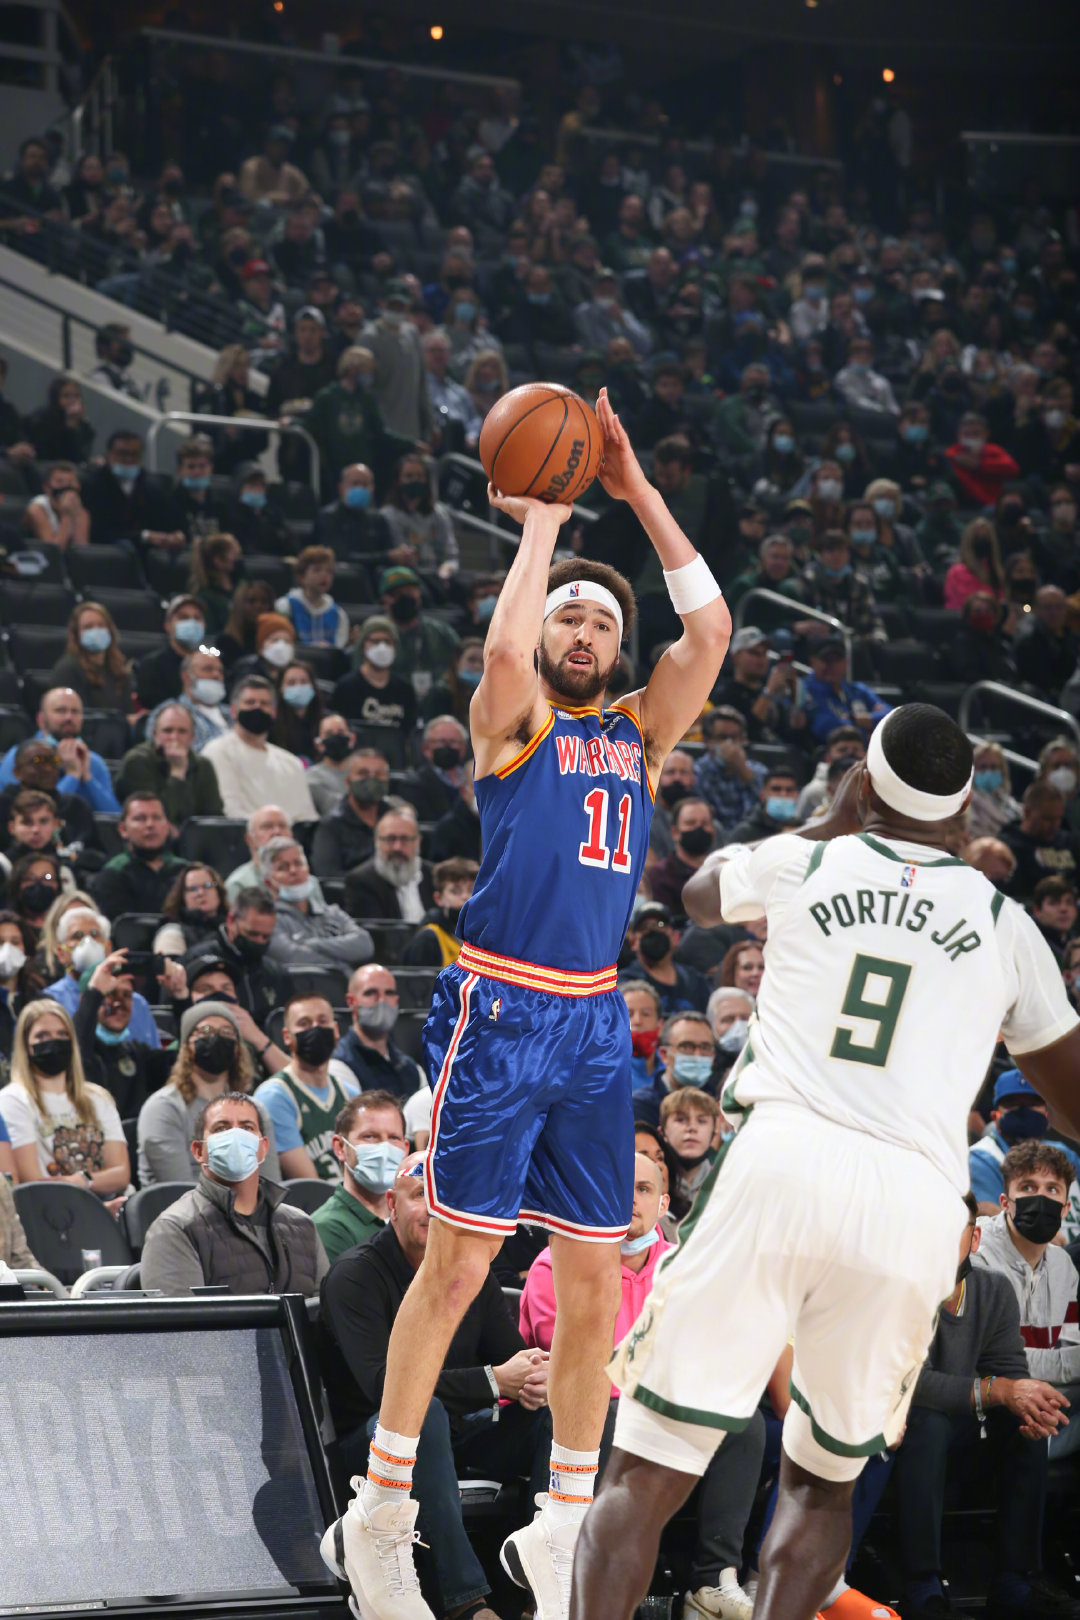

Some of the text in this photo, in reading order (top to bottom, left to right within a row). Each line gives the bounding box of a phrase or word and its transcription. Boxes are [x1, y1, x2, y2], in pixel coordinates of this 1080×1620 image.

[556, 734, 641, 786] WARORS
[579, 788, 631, 874] 11
[808, 889, 982, 962] PORTIS JR
[828, 951, 915, 1069] 9
